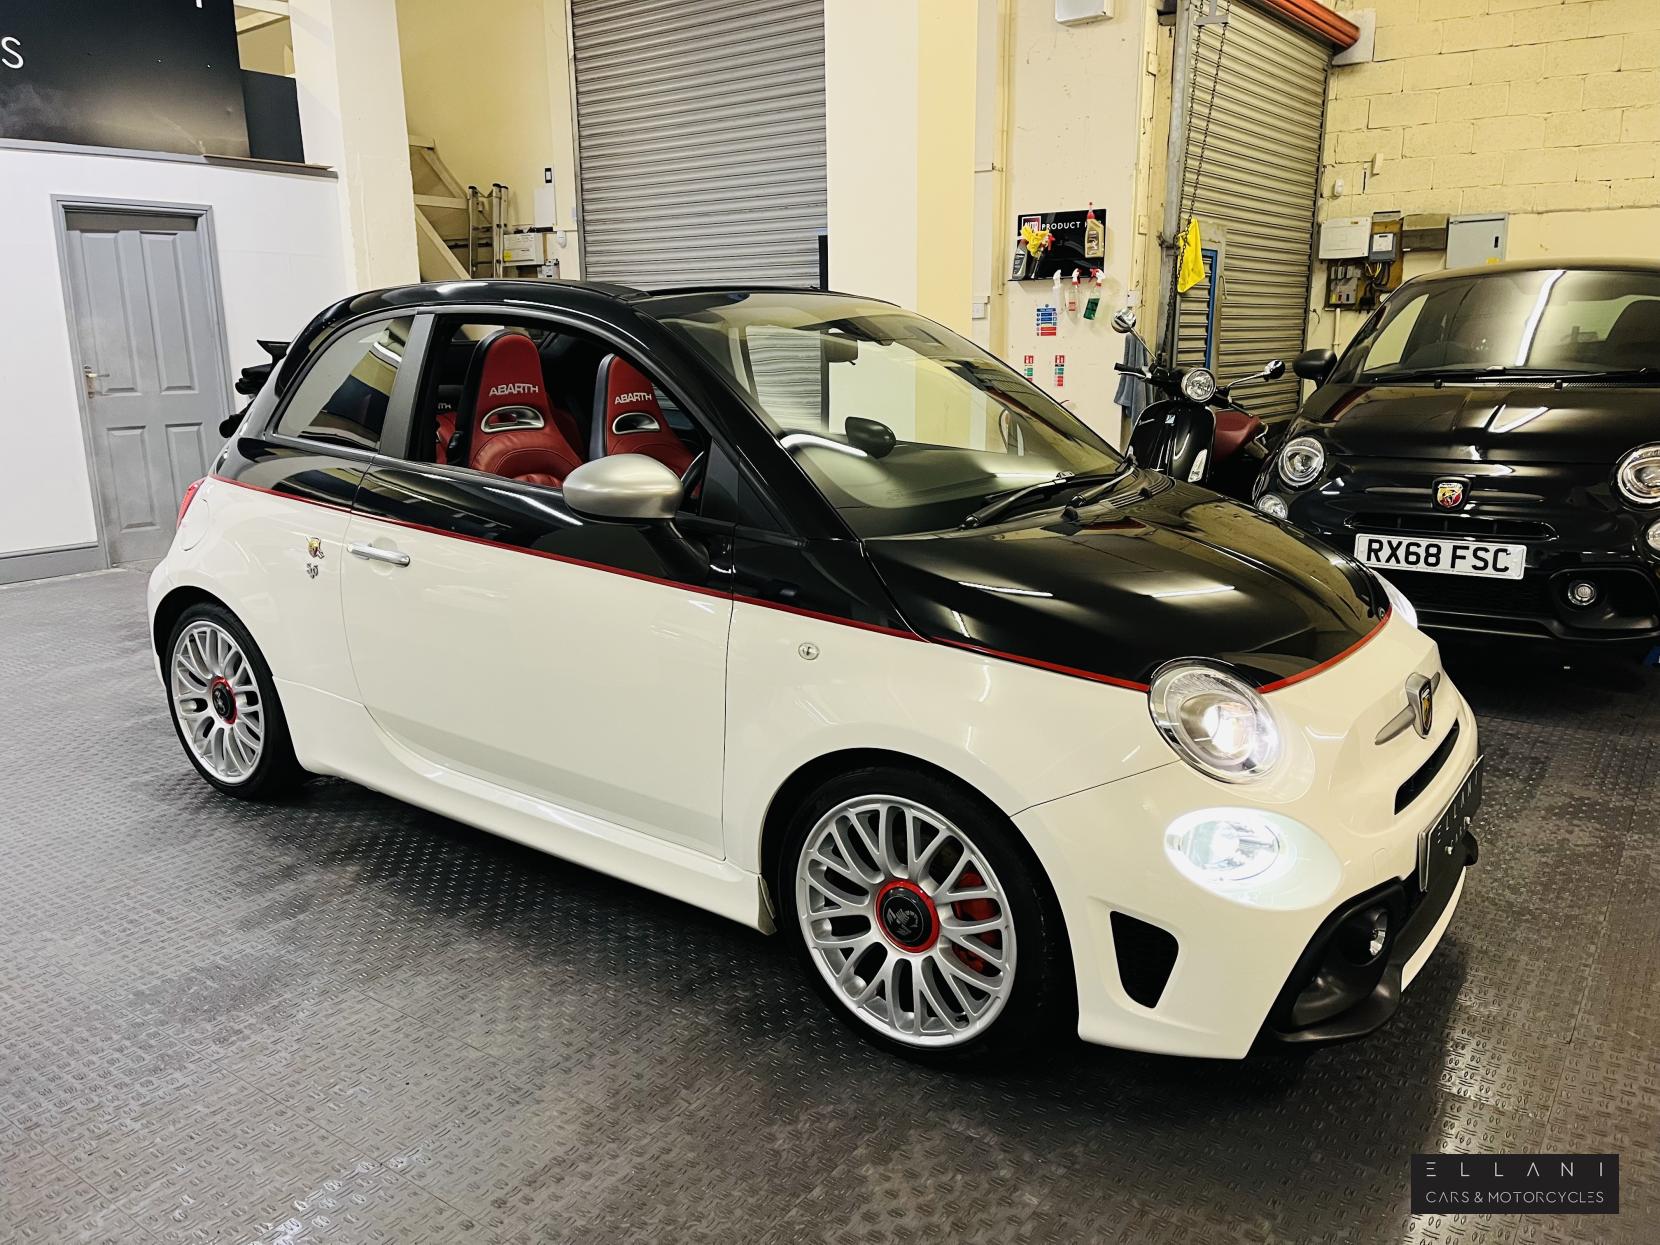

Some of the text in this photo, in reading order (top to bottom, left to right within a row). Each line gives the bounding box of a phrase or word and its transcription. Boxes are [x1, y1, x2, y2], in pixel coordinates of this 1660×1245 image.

[1041, 221, 1081, 231] PRODUCT
[488, 383, 539, 397] ABARTH
[614, 392, 652, 405] ABARTH
[1366, 538, 1510, 573] RX68 FSC
